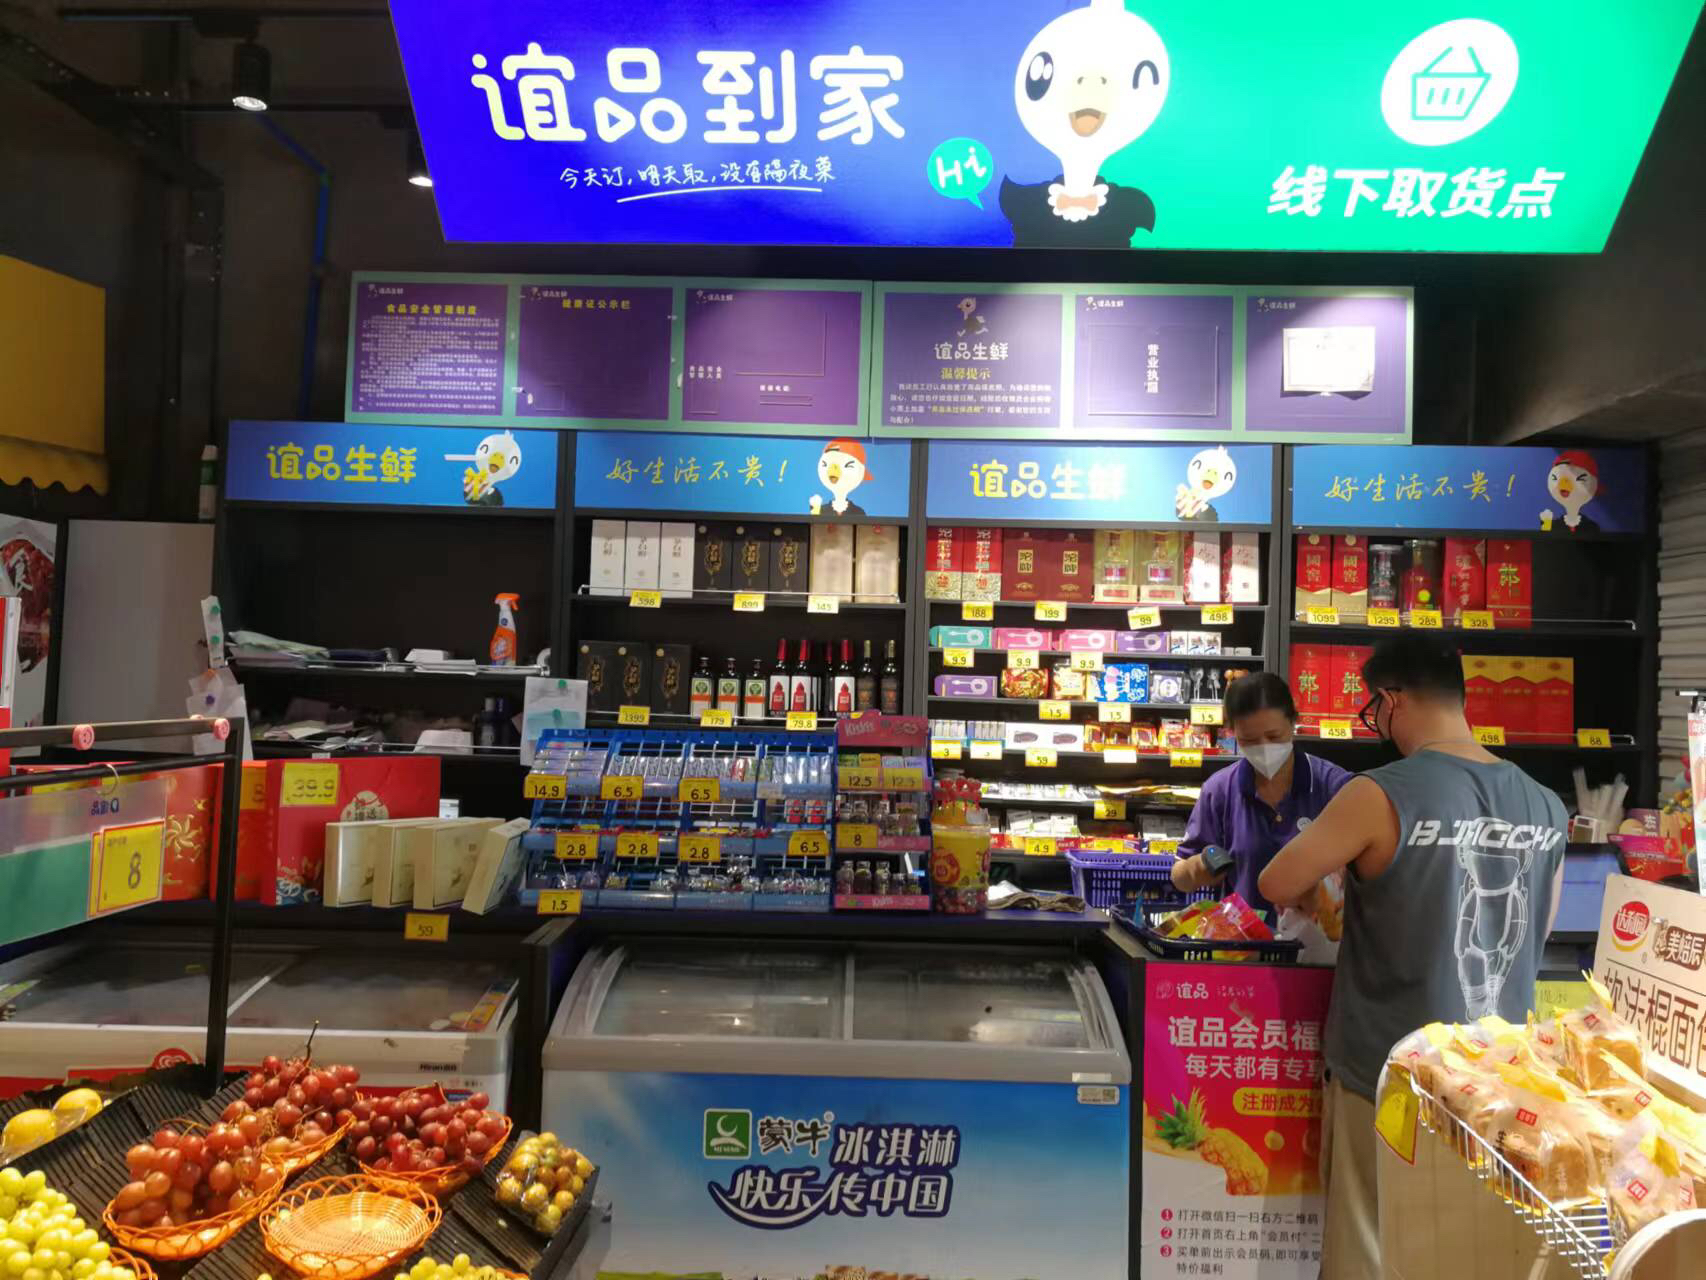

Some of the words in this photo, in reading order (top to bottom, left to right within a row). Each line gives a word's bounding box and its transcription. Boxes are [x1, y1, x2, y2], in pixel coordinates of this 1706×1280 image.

[471, 42, 905, 145] 谊品到家
[937, 148, 988, 188] Hi
[1266, 165, 1565, 219] 线下取货点
[934, 342, 1009, 361] 谊品生鲜
[267, 442, 417, 484] 谊品生鲜
[605, 456, 789, 488] 好生活不贵！
[969, 459, 1127, 500] 谊品生鲜
[1324, 470, 1516, 503] 好生活不贵！
[972, 608, 986, 617] 188
[1209, 612, 1227, 621] 498
[1374, 616, 1394, 624] 1299
[1471, 619, 1488, 627] 328
[952, 656, 966, 665] 9.9
[1050, 709, 1061, 717] 1.5
[1481, 735, 1499, 743] 498
[848, 775, 872, 787] 12.5
[533, 784, 560, 797] 14.9
[613, 786, 633, 798] 6.5
[690, 788, 710, 800] 6.5
[1106, 809, 1116, 817] 29
[853, 834, 862, 847] 8
[567, 844, 587, 856] 2.8
[628, 842, 648, 854] 2.8
[800, 841, 820, 853] 6.5
[1034, 845, 1049, 853] 4.9
[690, 847, 710, 860] 2.8
[127, 851, 142, 889] 8
[550, 899, 569, 911] 1.5
[1176, 982, 1209, 1000] 谊品
[1167, 1016, 1321, 1050] 谊品会员福
[758, 1116, 830, 1157] 蒙牛
[833, 1126, 957, 1167] 冰淇淋
[727, 1168, 950, 1215] 快乐传中国
